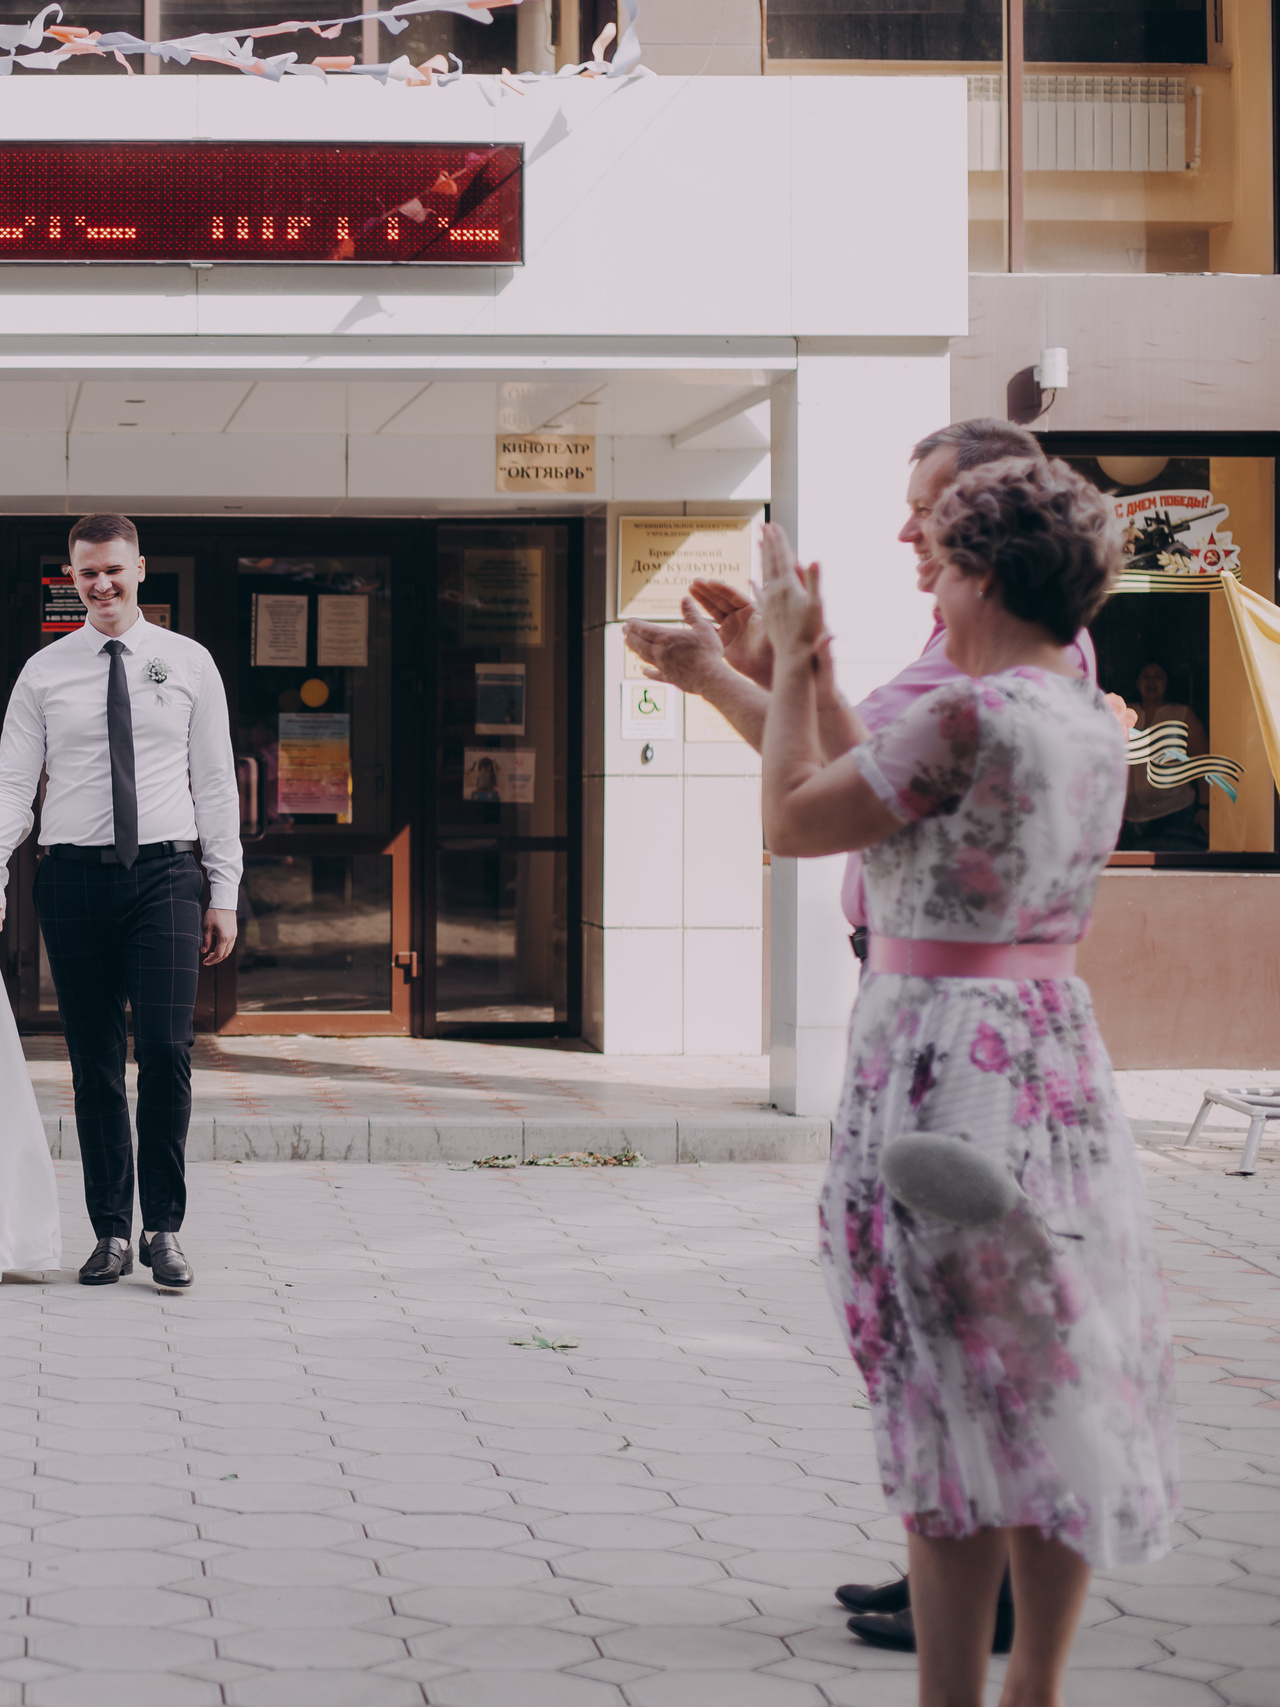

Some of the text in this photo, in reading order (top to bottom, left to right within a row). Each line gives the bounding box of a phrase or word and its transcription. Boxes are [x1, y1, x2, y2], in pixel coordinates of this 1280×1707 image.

[502, 442, 590, 454] КИНОТЕАТР
[499, 466, 593, 480] "ОКТЯБРЬ"
[1115, 503, 1123, 518] С
[1160, 495, 1210, 509] ПОБЕДЫ!
[631, 559, 740, 575] Дом культуры
